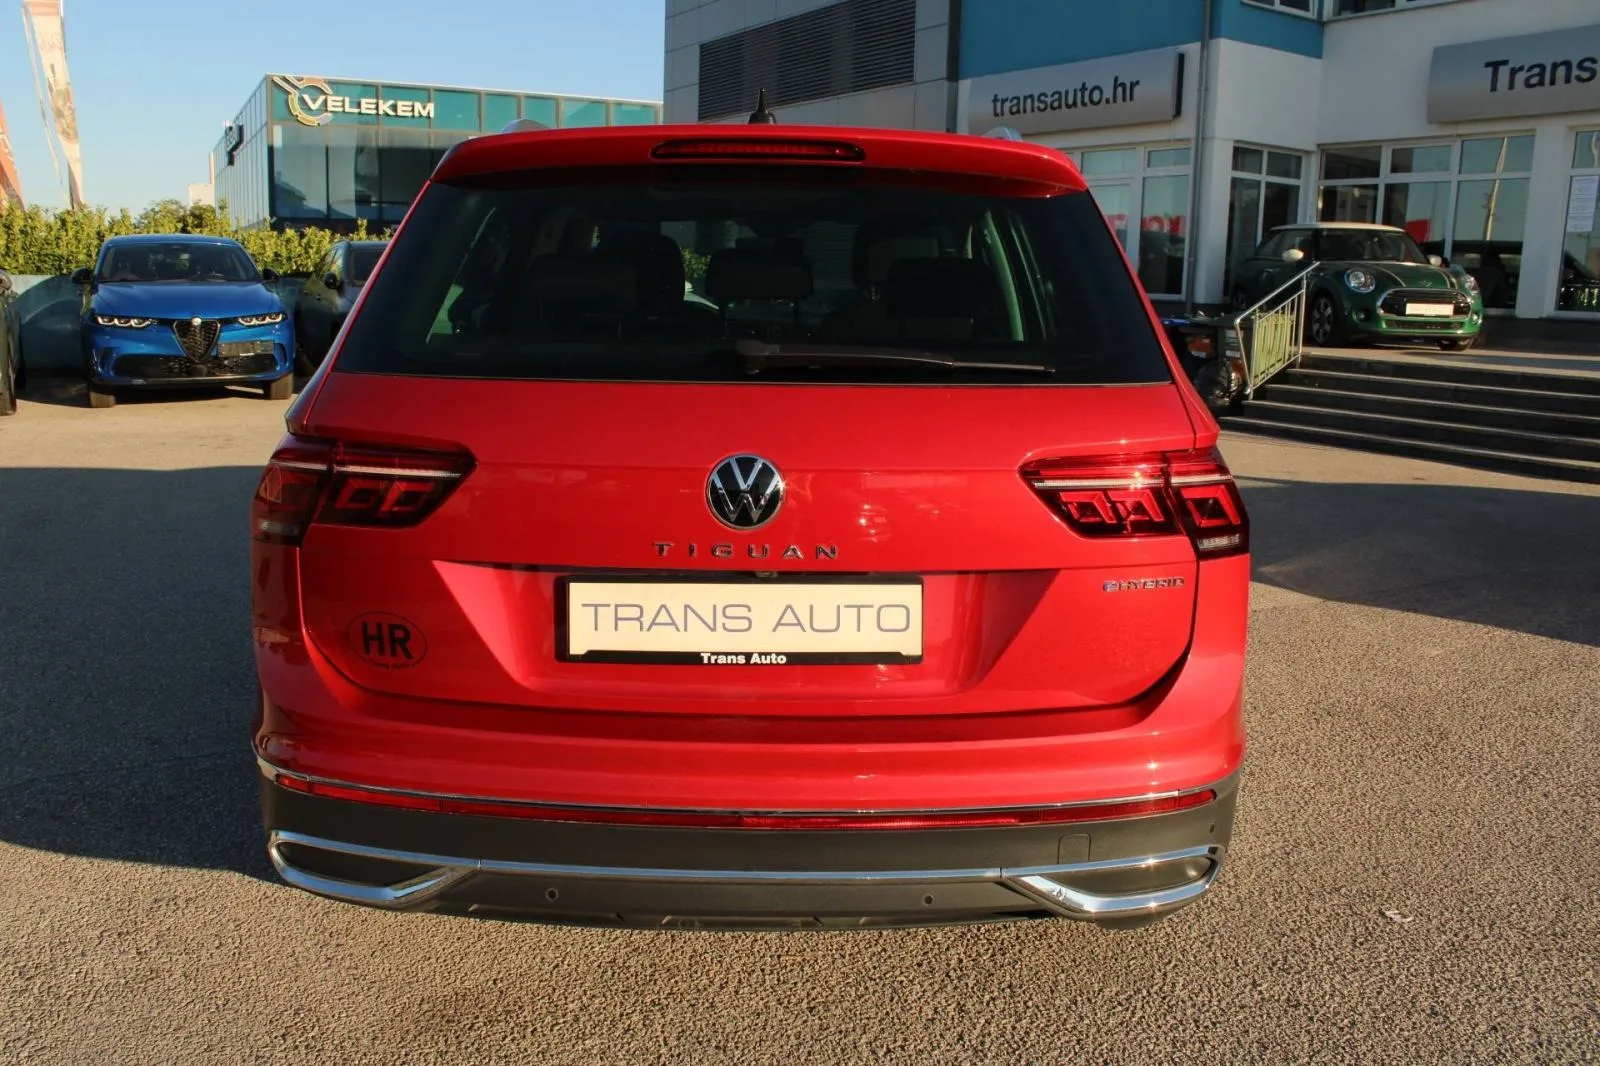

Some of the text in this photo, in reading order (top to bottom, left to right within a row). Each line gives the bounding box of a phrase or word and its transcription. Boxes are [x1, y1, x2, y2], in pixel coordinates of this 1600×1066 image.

[1483, 56, 1598, 93] Trans
[302, 94, 434, 118] VELEKEM
[991, 75, 1140, 118] transauto.hr
[653, 541, 838, 560] TIGUAN
[582, 603, 911, 633] TRANS AUTO
[361, 621, 413, 660] HR
[700, 652, 787, 664] Trans Auto
